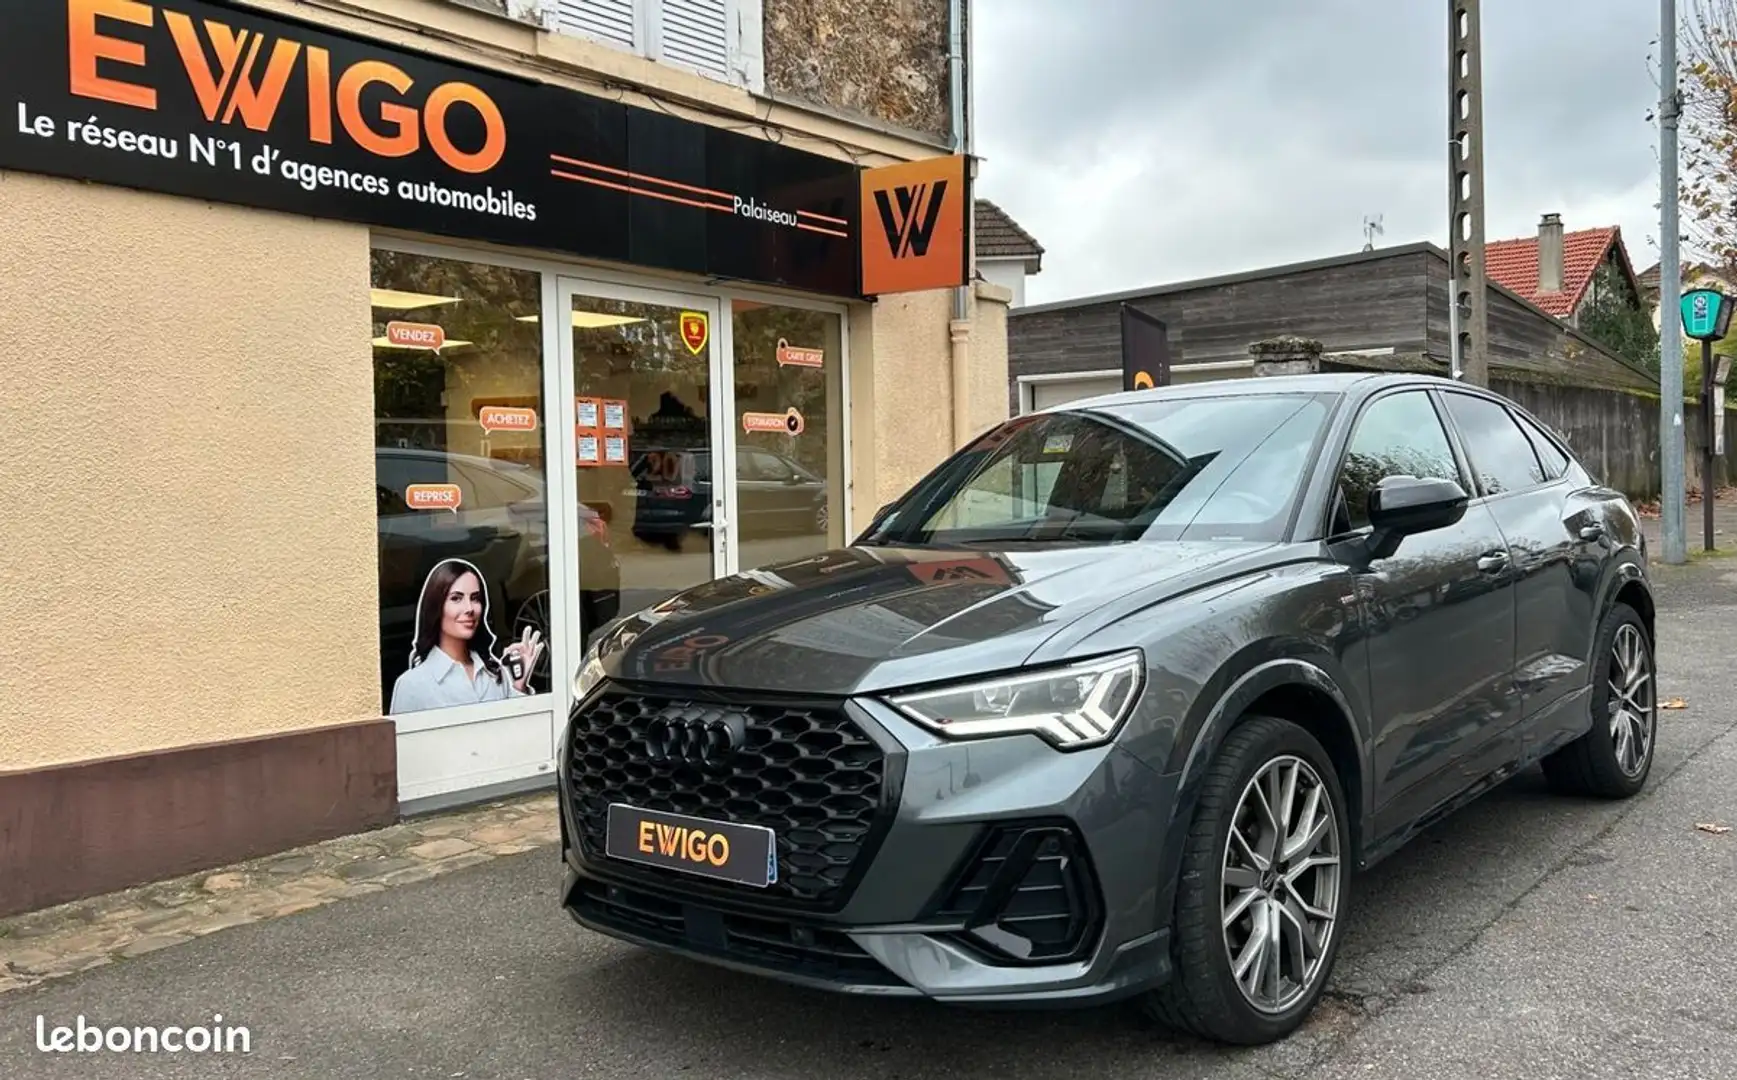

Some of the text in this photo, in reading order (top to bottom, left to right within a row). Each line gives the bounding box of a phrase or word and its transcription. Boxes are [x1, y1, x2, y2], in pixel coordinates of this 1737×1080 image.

[68, 0, 507, 174] EWIGO
[18, 102, 537, 221] Le réseau N°1 d'agences automobiles
[733, 195, 798, 227] Palaiseau
[391, 327, 436, 343] VENDEZ
[487, 413, 530, 425] ACHETEZ
[413, 490, 455, 503] REPRISE
[639, 820, 730, 867] EWIGO
